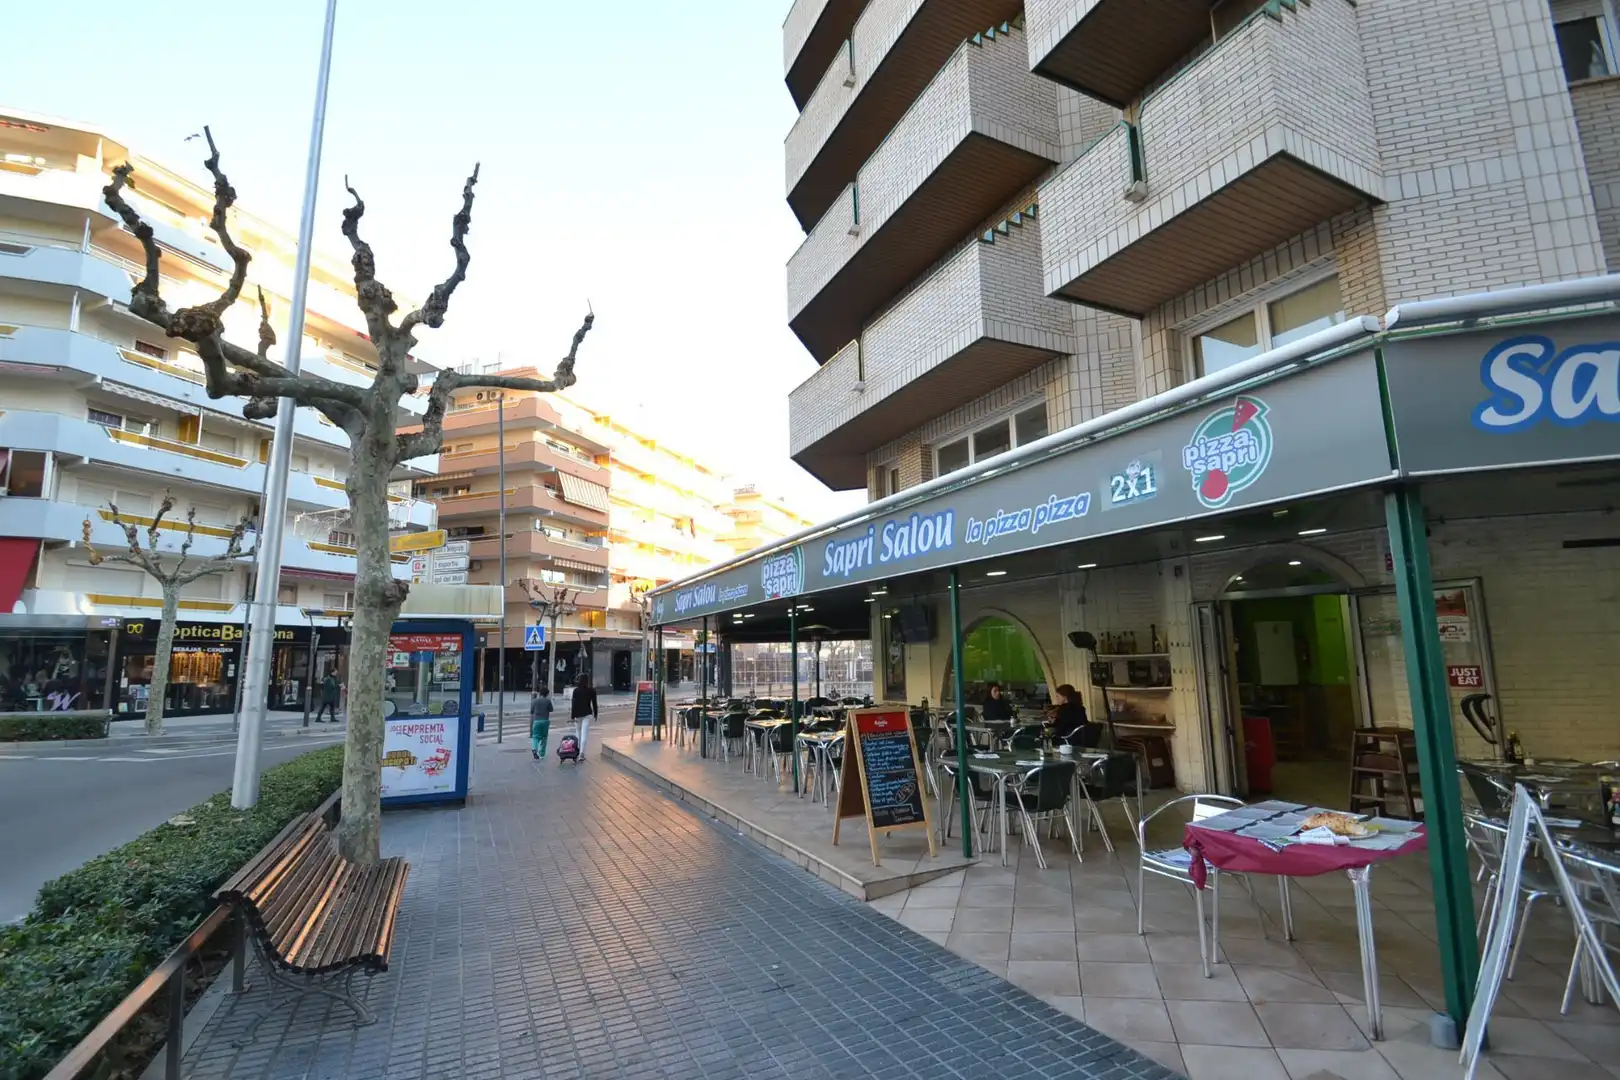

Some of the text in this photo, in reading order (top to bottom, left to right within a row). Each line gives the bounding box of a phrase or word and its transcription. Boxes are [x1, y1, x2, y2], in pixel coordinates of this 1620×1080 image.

[1184, 429, 1252, 467] pizza
[1193, 440, 1258, 474] sapri
[1110, 466, 1158, 504] 2x1
[822, 492, 1091, 577] Sapri Salou la pizza pizza
[763, 557, 796, 583] pizza
[694, 583, 717, 607] Salou
[766, 573, 797, 596] sapri
[1450, 667, 1478, 677] JUST
[1457, 677, 1480, 685] EAT
[403, 723, 445, 735] EMPREMTA
